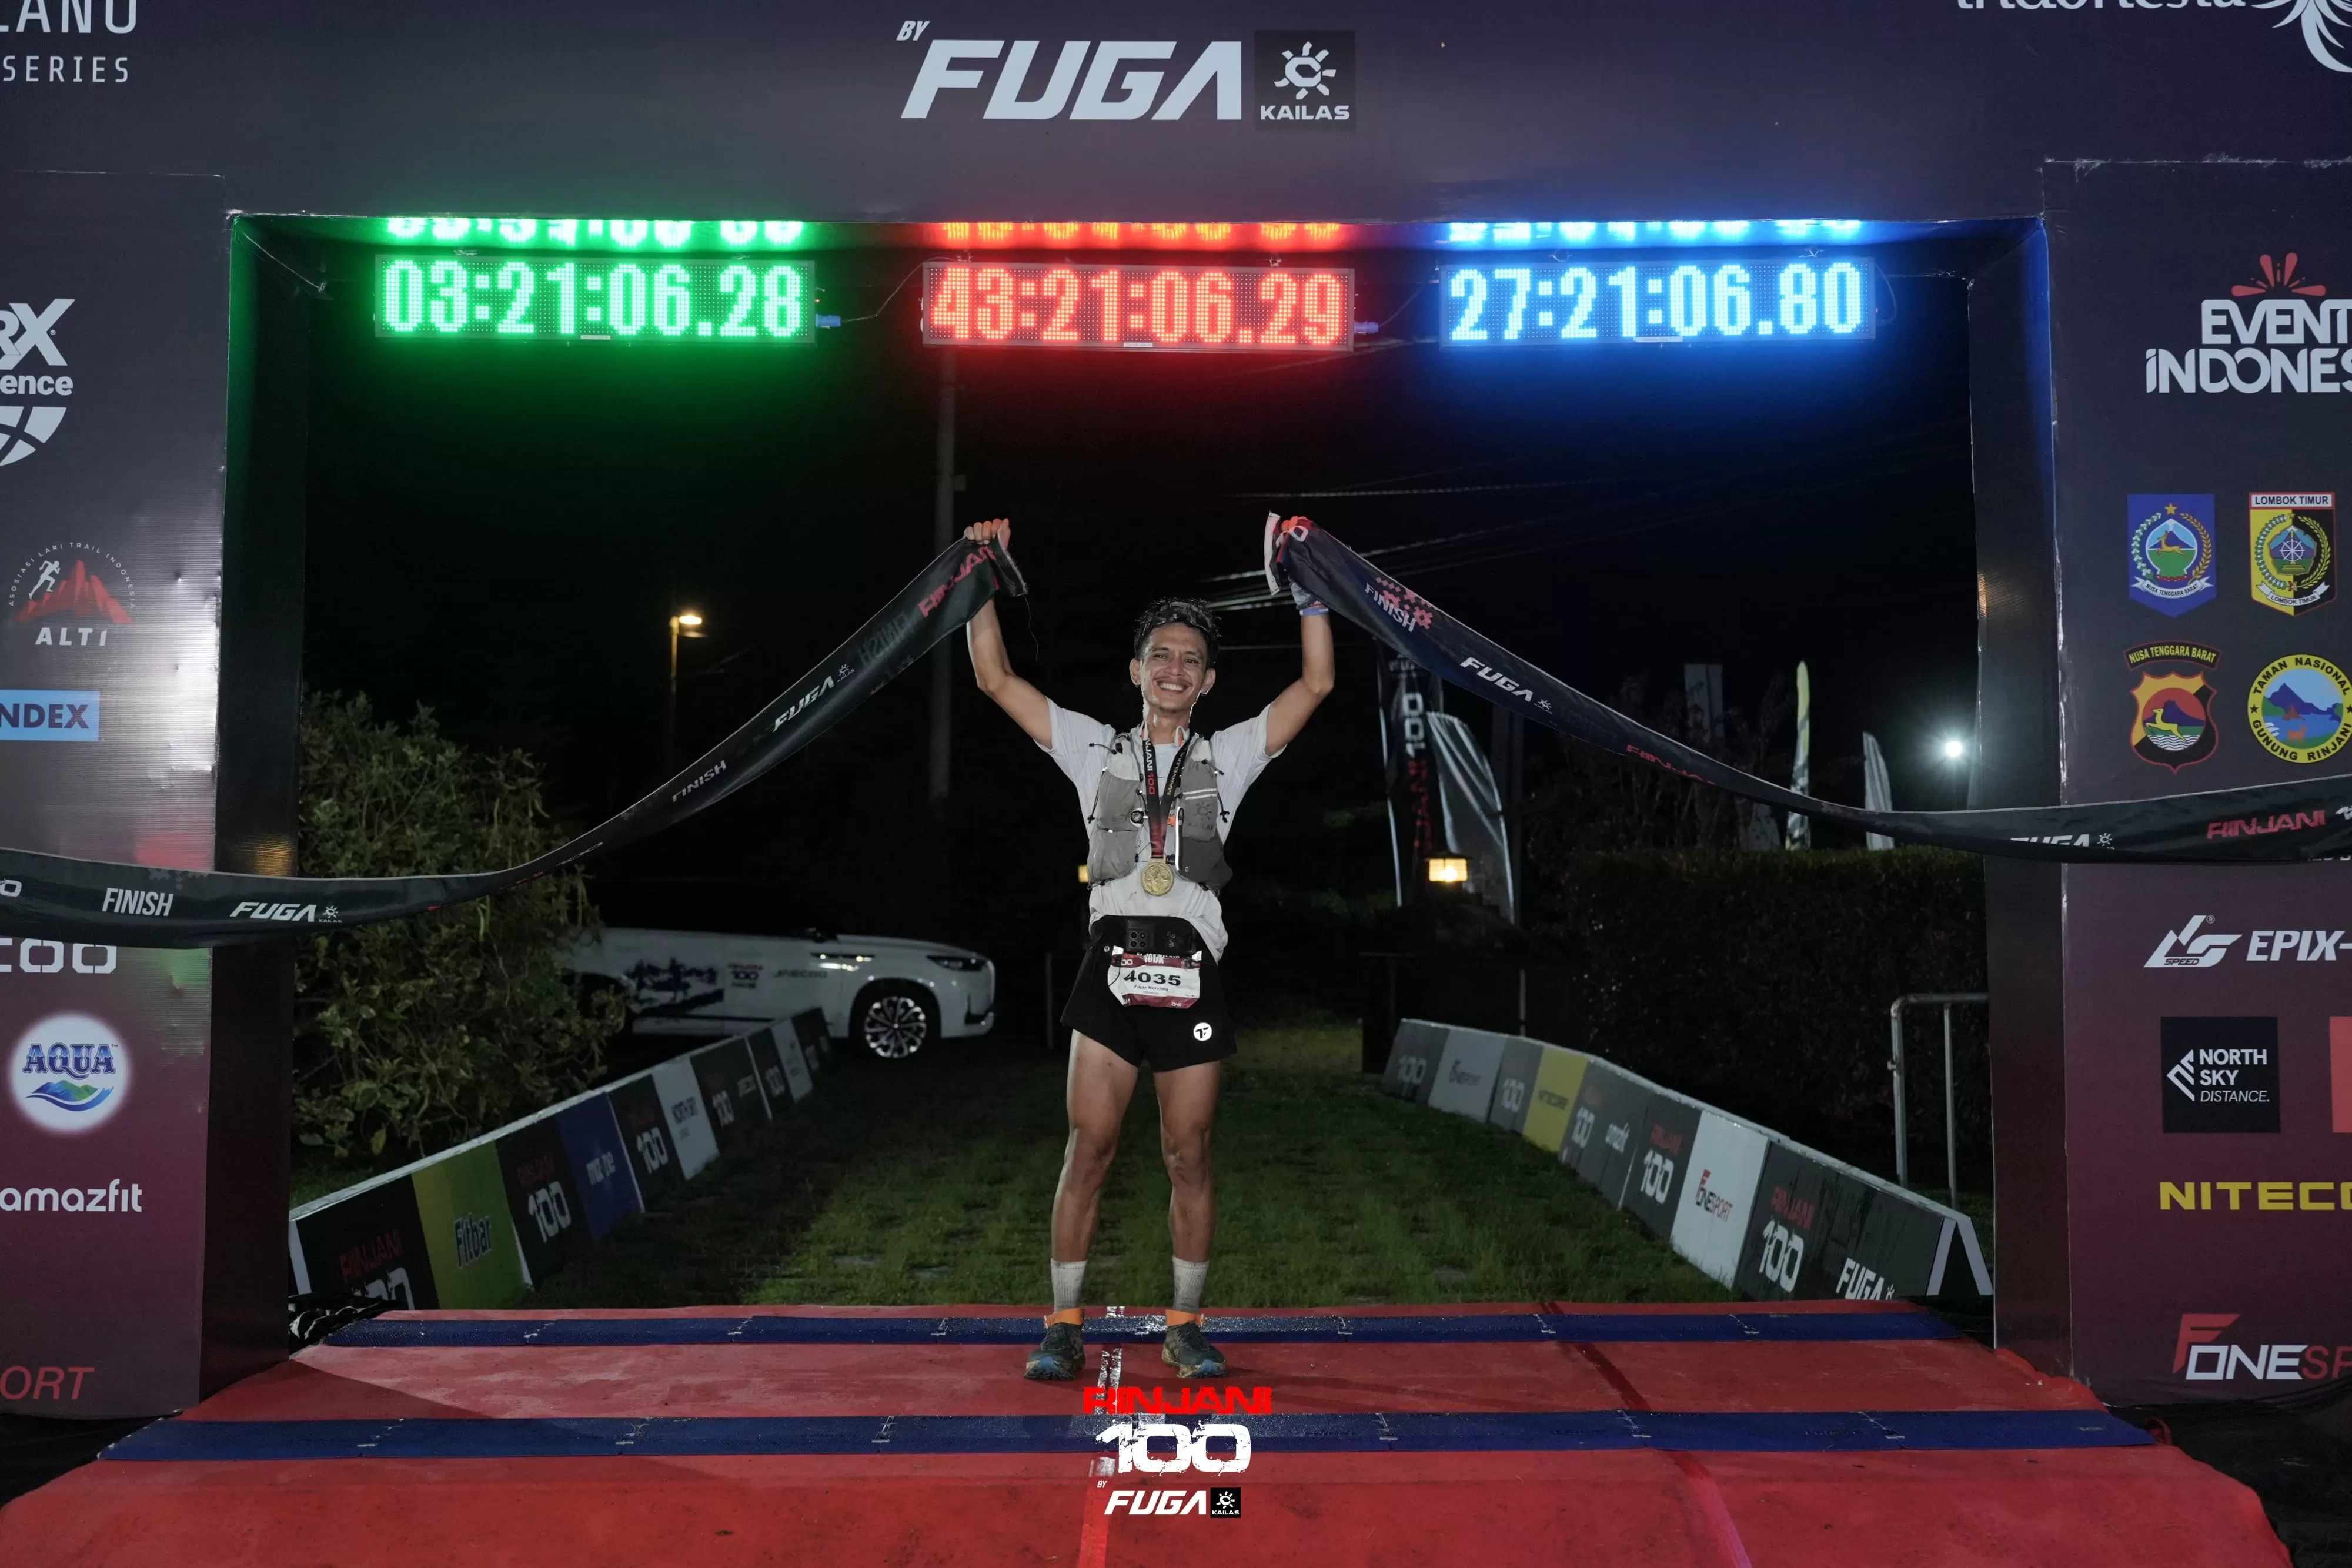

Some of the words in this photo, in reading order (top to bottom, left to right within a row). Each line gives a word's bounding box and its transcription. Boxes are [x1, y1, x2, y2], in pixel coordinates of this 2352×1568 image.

[897, 21, 930, 41] BY
[3, 55, 128, 83] SERIES
[901, 39, 1242, 121] FUGA
[1260, 105, 1350, 121] KAILAS
[384, 259, 802, 338] 03:21:06.28
[933, 267, 1341, 345] 43:21:06.29
[1450, 262, 1862, 340] 27:21:06.80
[2255, 496, 2296, 506] LOMBOK
[2299, 495, 2329, 505] TIMUR
[9, 557, 35, 606] ASOSIASI
[38, 543, 63, 557] LARI
[69, 542, 101, 554] TRAIL
[106, 553, 136, 609] INDONESIA
[2145, 583, 2159, 593] NUSA
[2159, 589, 2184, 597] TENGGARA
[1365, 583, 1416, 632] FINISH
[2271, 596, 2294, 605] LOMBOK
[2296, 594, 2317, 604] TIMUR
[35, 627, 108, 646] ALTI
[2129, 648, 2149, 663] NUSA
[2150, 645, 2190, 657] TENGGARA
[2191, 647, 2216, 663] BARAT
[1460, 656, 1534, 702] FUGA
[2253, 660, 2287, 694] TAMAN
[2294, 657, 2350, 696] NASIONAL
[772, 676, 835, 732] FUGA
[2253, 719, 2298, 760] GUNUNG
[2307, 723, 2352, 760] RINJANI
[2207, 809, 2326, 840] RINJANI
[102, 887, 174, 917] FINISH
[230, 902, 317, 923] FUGA
[0, 938, 117, 974] OO
[1124, 969, 1181, 987] 4035
[22, 1042, 116, 1080] AQUA
[2199, 1048, 2267, 1065] NORTH
[2199, 1069, 2239, 1086] SKY
[2200, 1090, 2270, 1102] DISTANCE.
[0, 1178, 142, 1212] amazfit
[1640, 1149, 1675, 1205] 100
[529, 1181, 572, 1243] 100
[2160, 1181, 2352, 1211] NITEC
[1759, 1218, 1805, 1293] 100
[1835, 1256, 1886, 1300] FUGA
